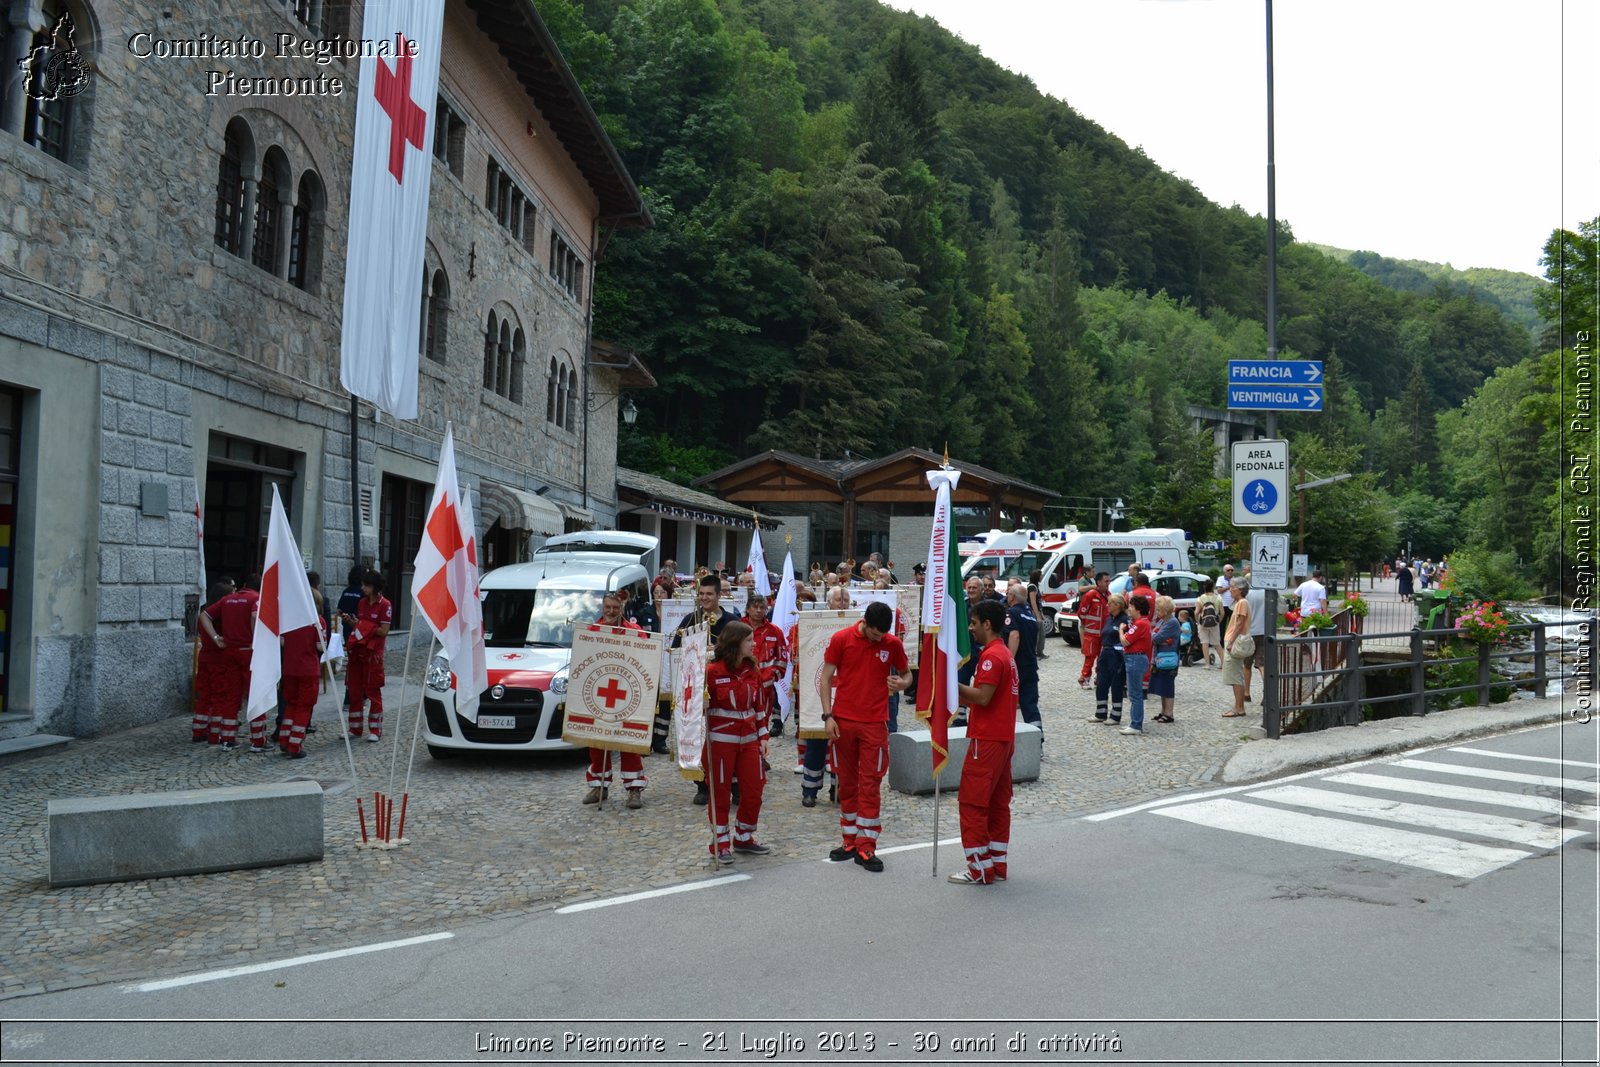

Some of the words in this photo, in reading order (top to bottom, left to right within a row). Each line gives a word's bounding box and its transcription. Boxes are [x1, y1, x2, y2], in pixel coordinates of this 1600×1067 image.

[1232, 366, 1292, 378] FRANCIA
[1232, 391, 1299, 404] VENTIMIGLIA
[1247, 450, 1272, 459] AREA
[1235, 461, 1285, 471] PEDONALE
[933, 526, 946, 563] LIMONE
[935, 565, 945, 574] DI
[932, 576, 944, 625] COMITATO
[579, 634, 594, 643] CORPO
[633, 642, 656, 650] SOCCORSO
[572, 657, 594, 679] CROCE
[595, 651, 626, 661] ROSSA
[627, 657, 654, 691] ITALIANA
[567, 723, 603, 735] COMITATO
